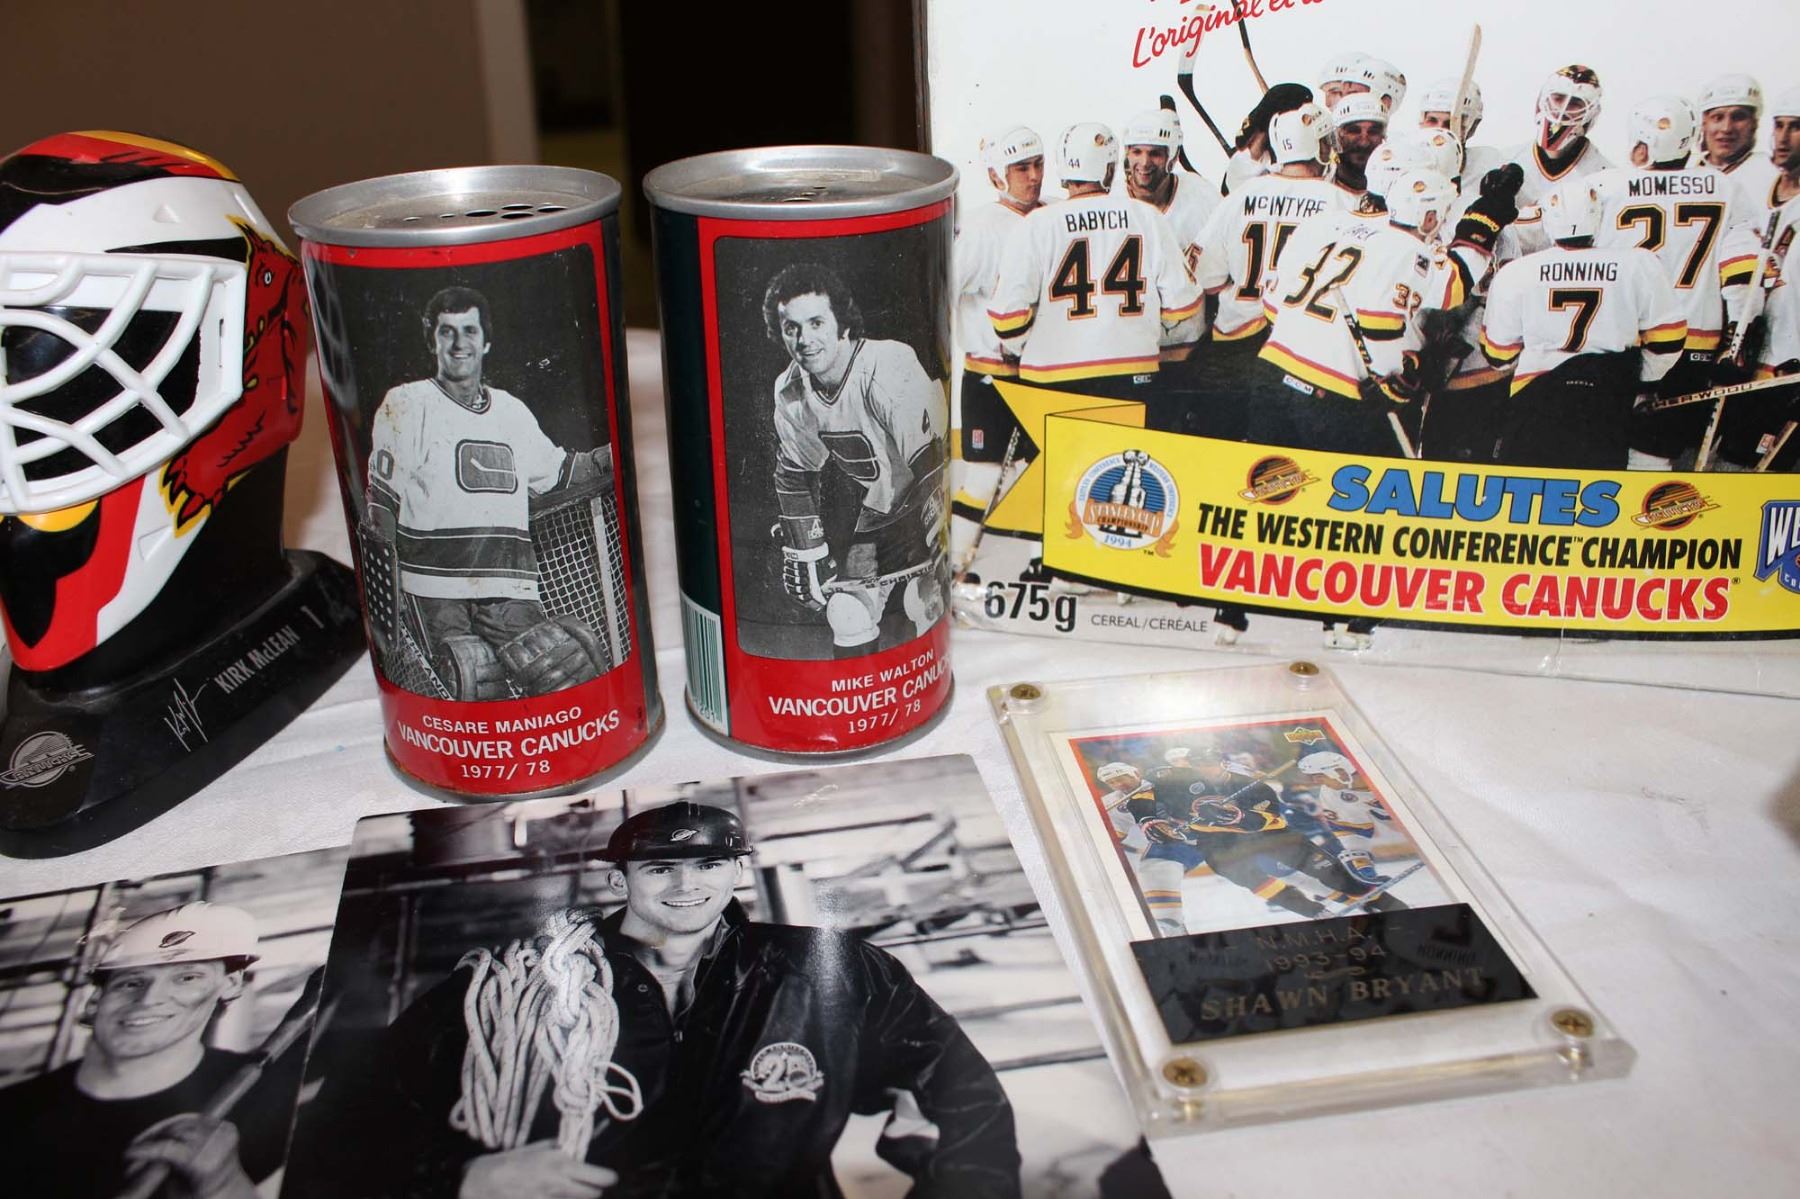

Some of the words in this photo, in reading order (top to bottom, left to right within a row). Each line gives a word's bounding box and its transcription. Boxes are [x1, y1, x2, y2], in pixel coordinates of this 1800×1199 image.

[1628, 174, 1716, 198] MOMESSO
[1065, 209, 1129, 233] BABYCH
[1616, 201, 1727, 290] 27
[1048, 234, 1148, 321] 44
[1283, 241, 1365, 323] 32
[1539, 261, 1618, 284] RONNING
[1548, 287, 1603, 353] 7
[1327, 464, 1622, 529] SALUTES
[1103, 534, 1133, 548] 1994
[1198, 503, 1246, 540] THE
[1256, 511, 1384, 556] WESTERN
[1585, 537, 1743, 570] CHAMPION
[1199, 541, 1486, 614] VANCOUVER
[984, 581, 1077, 632] 675g
[213, 660, 254, 695] KIRK
[250, 625, 301, 670] McLEAN
[831, 674, 875, 693] MIKE
[879, 649, 935, 682] WALTON
[422, 715, 490, 735] CESARE
[495, 706, 582, 734] MANIAGO
[768, 687, 897, 718] VANCOUVER
[397, 719, 513, 760] VANCOUVER
[520, 709, 621, 757] CANUCKS
[1266, 944, 1388, 973] 1993-94
[1200, 985, 1329, 1023] SHAWN
[1350, 967, 1485, 1003] BRYANT
